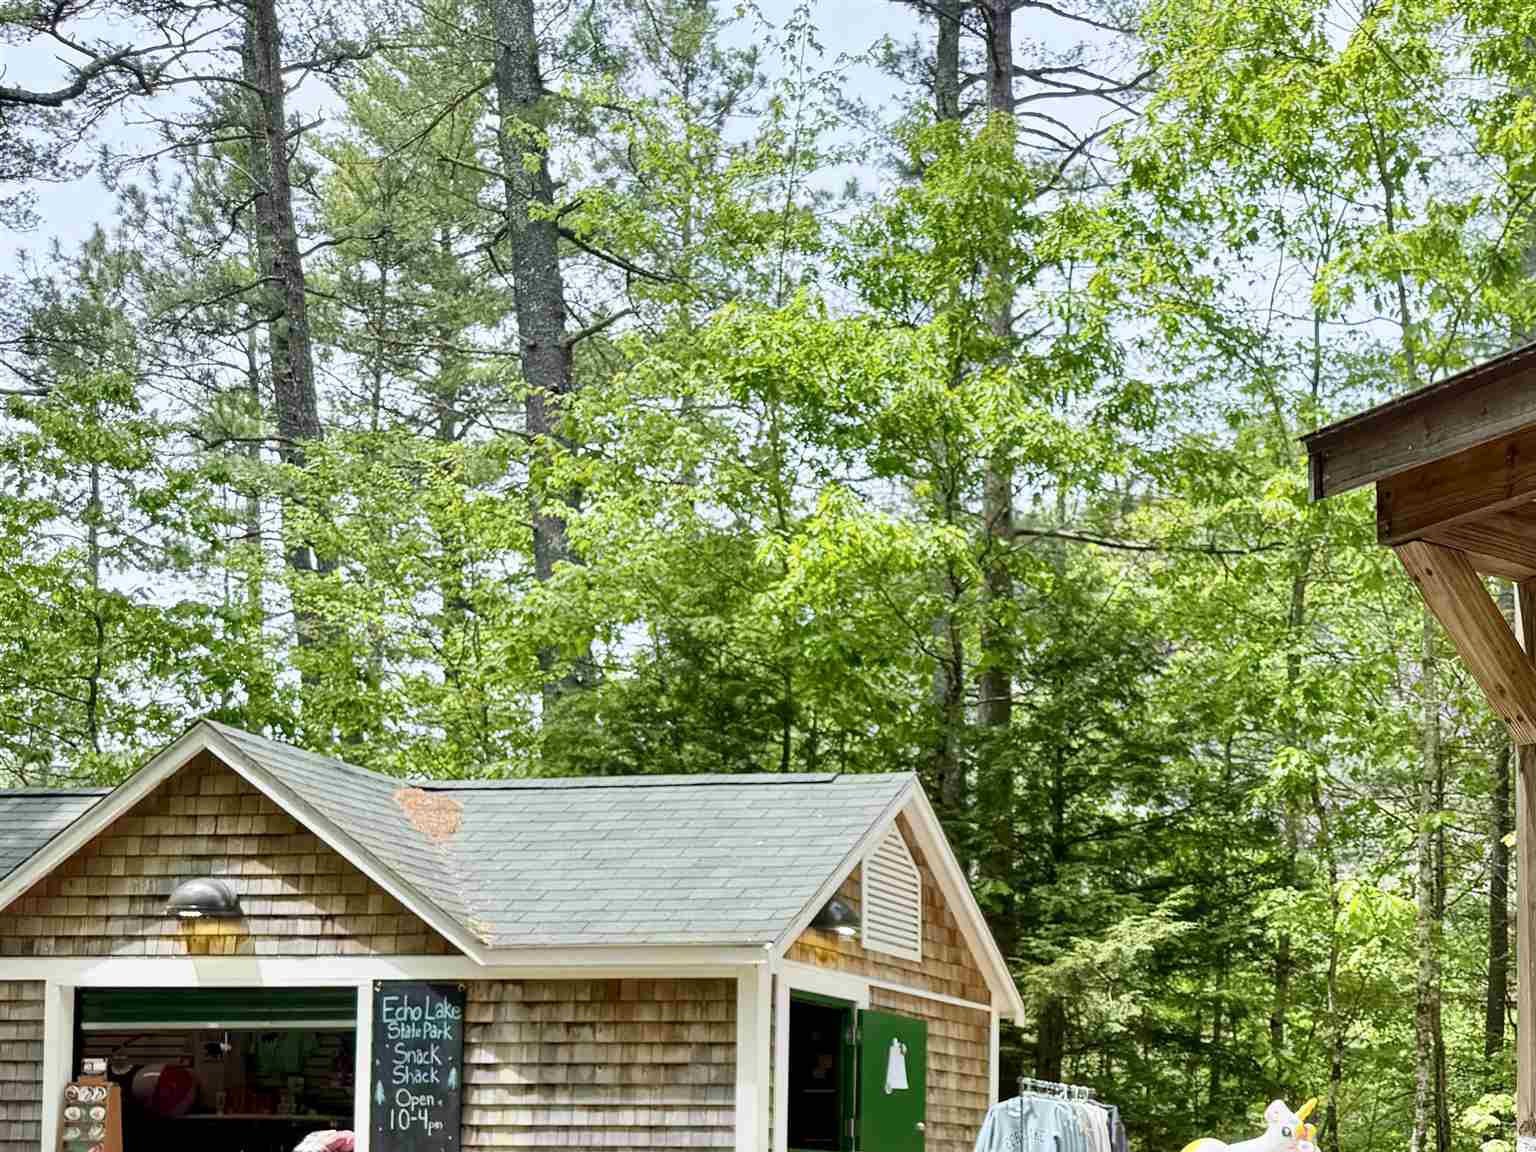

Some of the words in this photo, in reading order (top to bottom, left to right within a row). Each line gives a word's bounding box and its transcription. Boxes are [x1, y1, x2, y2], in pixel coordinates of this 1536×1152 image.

[382, 995, 423, 1023] Echo
[424, 995, 463, 1020] Lake
[387, 1022, 421, 1040] State
[423, 1022, 453, 1040] Park
[392, 1042, 442, 1065] Snack
[392, 1065, 440, 1085] Shack
[395, 1088, 434, 1112] Open
